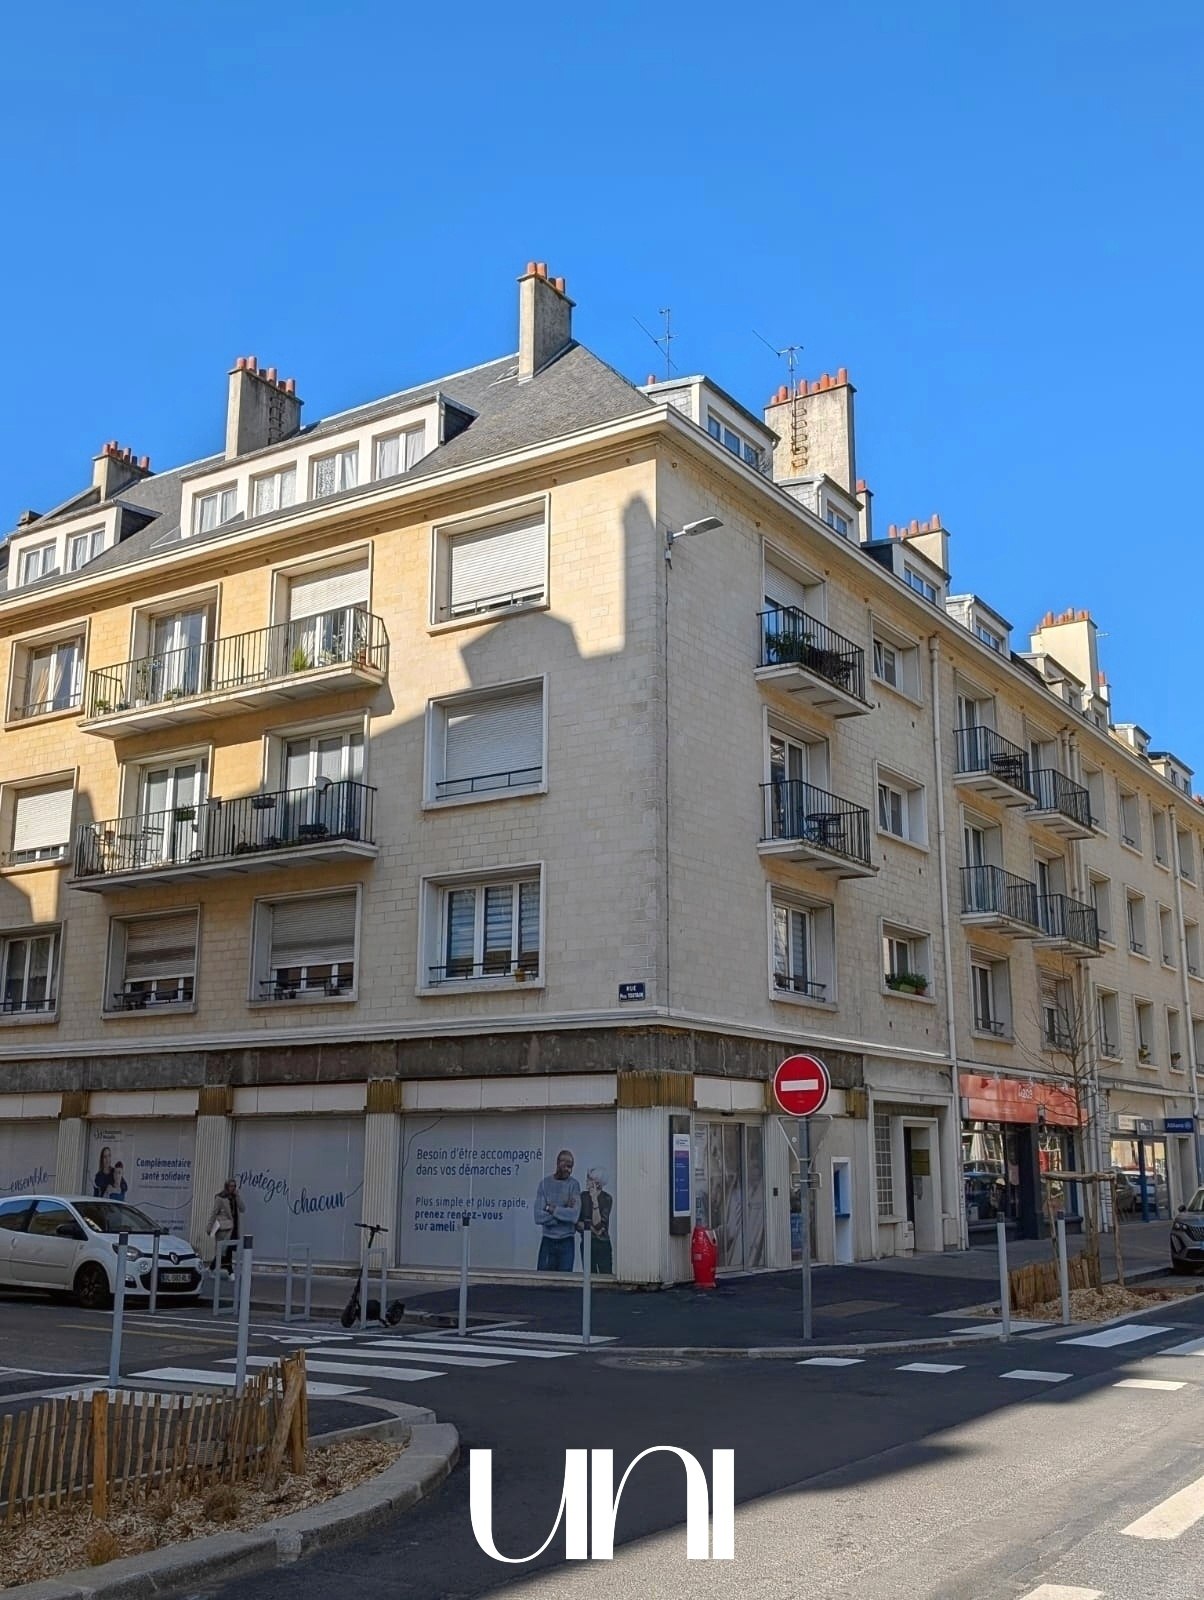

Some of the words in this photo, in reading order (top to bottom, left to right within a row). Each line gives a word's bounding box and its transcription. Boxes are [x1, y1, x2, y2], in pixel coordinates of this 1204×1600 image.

[416, 1148, 448, 1160] Besoin
[450, 1148, 478, 1160] d'être
[480, 1148, 542, 1163] accompagné
[136, 1157, 192, 1170] Complémentaire
[416, 1164, 438, 1176] dans
[441, 1165, 456, 1176] vos
[459, 1163, 512, 1176] démarches
[514, 1164, 520, 1176] ?
[10, 1166, 49, 1193] ensemble
[141, 1170, 160, 1181] santé
[161, 1170, 191, 1181] solidaire
[238, 1169, 288, 1203] protéger
[293, 1187, 346, 1216] chacun
[415, 1197, 433, 1207] Plus
[436, 1197, 463, 1209] simple
[466, 1198, 475, 1207] et
[477, 1197, 496, 1209] plus
[498, 1198, 529, 1210] rapide,
[414, 1210, 444, 1221] prenez
[447, 1210, 504, 1221] rendez-vous
[414, 1222, 428, 1231] sur
[430, 1221, 455, 1232] ameli
